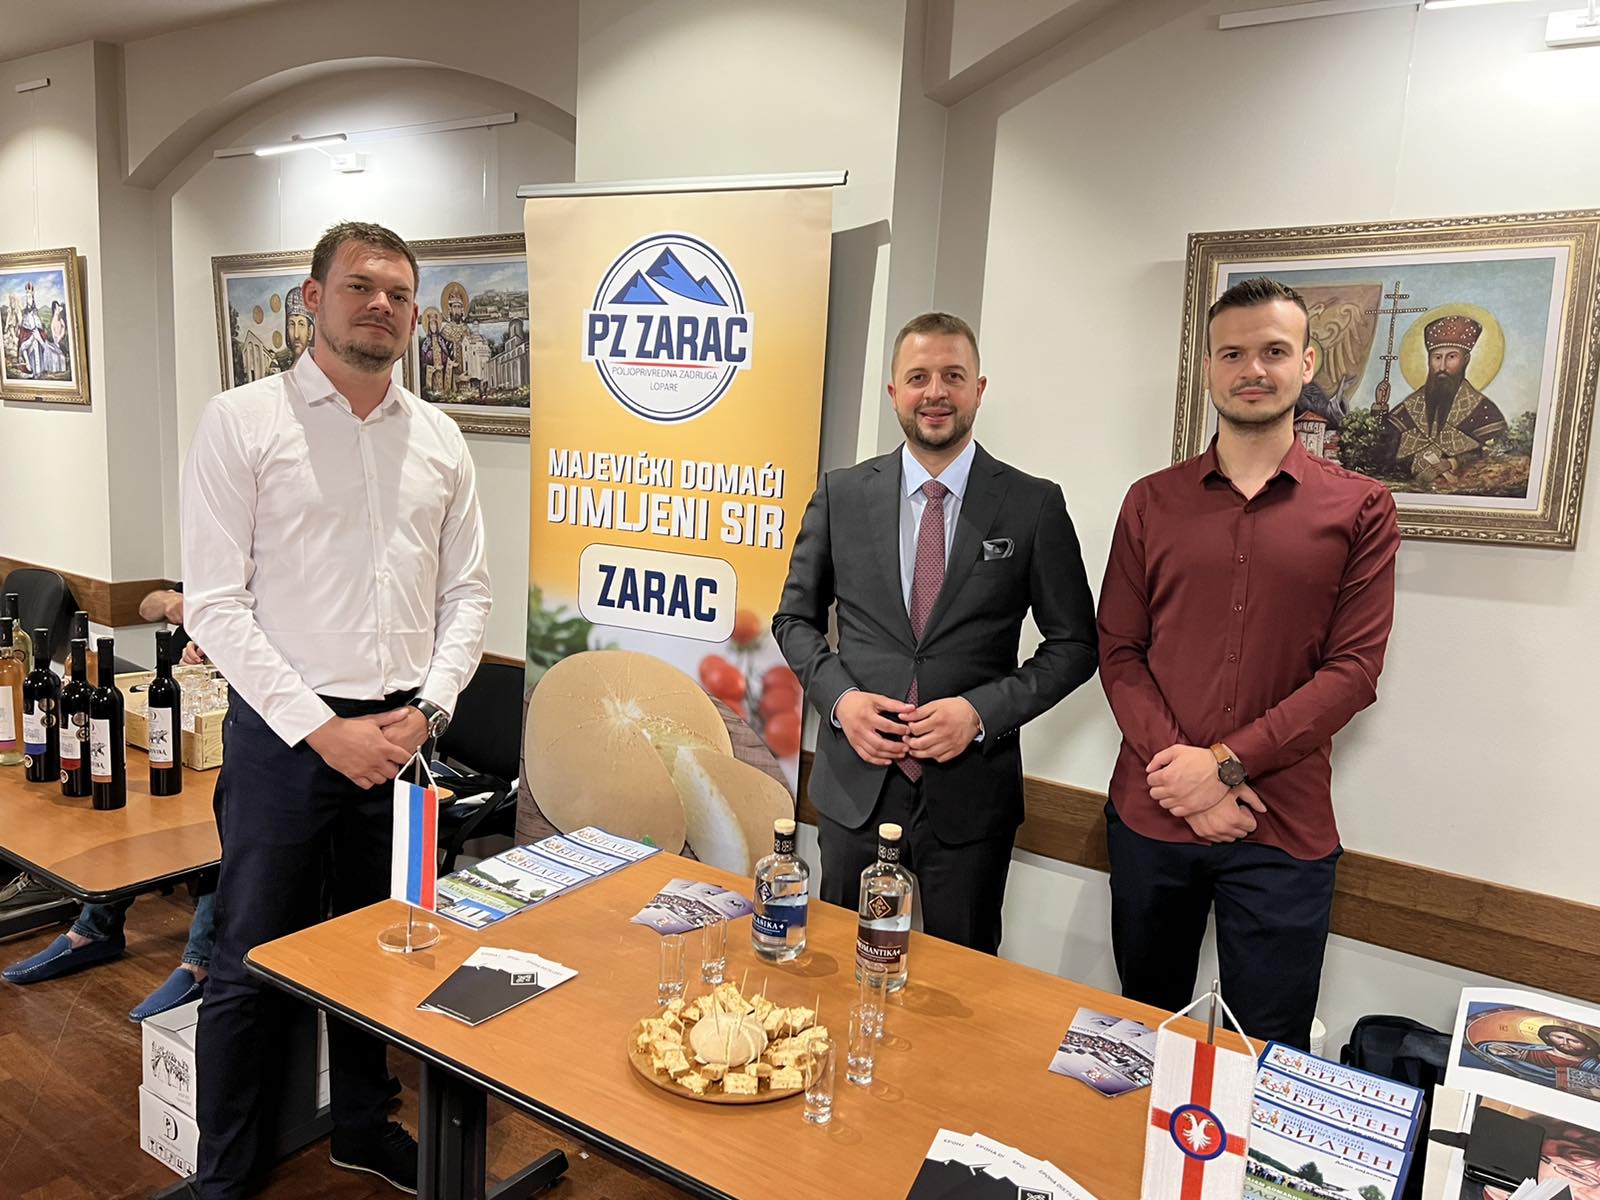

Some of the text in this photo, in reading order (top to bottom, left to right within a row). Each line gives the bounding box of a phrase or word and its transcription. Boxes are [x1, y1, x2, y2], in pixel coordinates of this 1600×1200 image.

[588, 313, 748, 363] PZ ZARAC
[612, 366, 718, 380] POLJOPRIVREDNA ZADRUGA
[650, 382, 678, 392] LOPARE
[549, 448, 785, 499] MAJEVIČKI DOMAĆI
[547, 482, 785, 550] DIMLJENI SIR
[597, 564, 718, 623] ZARAC
[1304, 1067, 1406, 1106] БИЛТЕН
[1293, 1093, 1399, 1136] БИЛТЕН
[1280, 1124, 1392, 1170] БИЛТЕН
